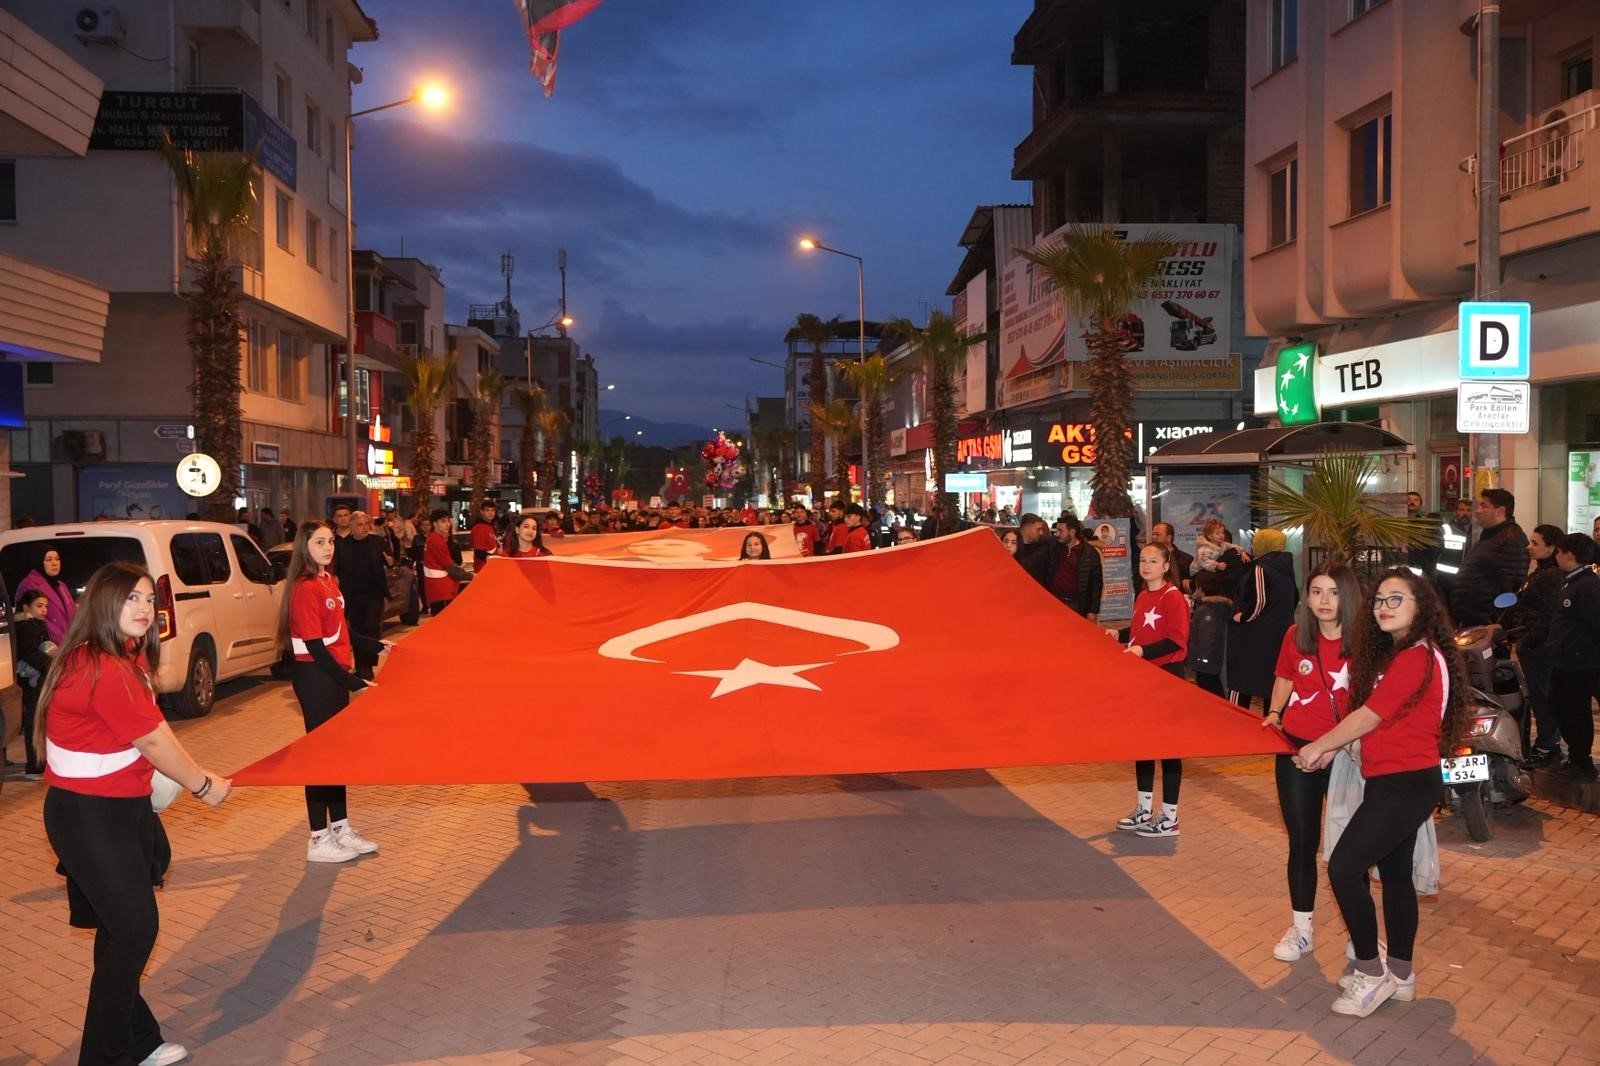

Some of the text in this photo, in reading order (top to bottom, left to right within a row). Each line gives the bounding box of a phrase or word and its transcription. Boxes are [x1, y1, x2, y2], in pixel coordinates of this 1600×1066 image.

[116, 96, 200, 109] TURGUT
[140, 111, 150, 121] &
[183, 126, 230, 137] TURGUT
[1152, 290, 1174, 299] 0537
[1176, 290, 1193, 299] 370
[1195, 290, 1206, 299] 60
[1208, 290, 1220, 299] 67
[1480, 321, 1509, 361] D
[1335, 359, 1382, 393] TEB
[1469, 403, 1517, 412] Park Edilen
[984, 433, 1002, 460] GSM
[1466, 756, 1486, 767] ARJ
[1455, 770, 1475, 781] 534
